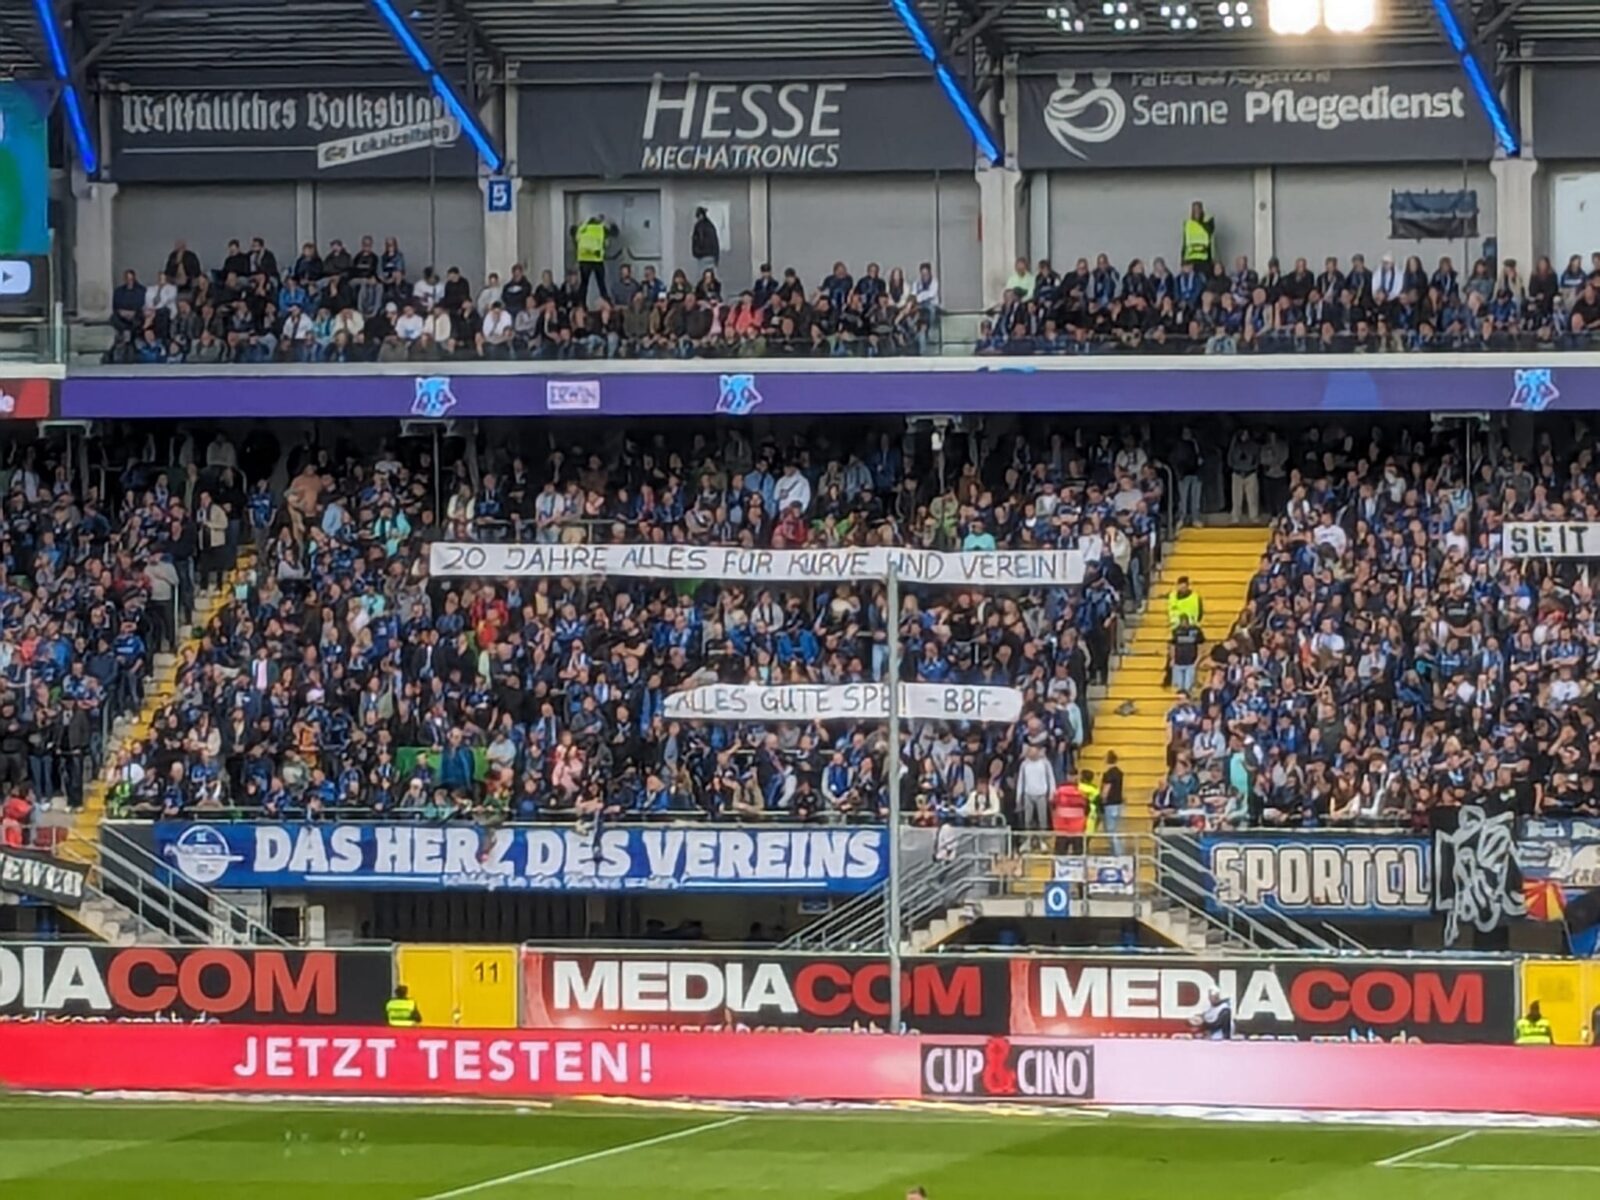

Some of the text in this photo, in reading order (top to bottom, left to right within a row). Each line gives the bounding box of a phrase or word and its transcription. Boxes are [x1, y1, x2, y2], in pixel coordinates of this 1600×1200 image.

[306, 90, 452, 131] Volksblat
[642, 72, 847, 139] HESSE
[1133, 86, 1465, 129] Senne Pflegedienst
[641, 144, 840, 171] MECHATRONICS
[492, 183, 508, 206] 5
[1511, 525, 1589, 554] SEIT
[442, 546, 487, 571] 20
[503, 547, 609, 571] JAHRE
[621, 548, 708, 572] ALLES
[787, 550, 880, 577] KURVE
[959, 553, 1068, 580] VEREIN!
[760, 687, 832, 713] GUTE
[253, 825, 882, 879] DAS HERZ DES VEREINS
[474, 960, 499, 984] 11
[553, 960, 982, 1017] MEDIACOM
[1040, 966, 1484, 1024] MEDIACOM
[233, 1036, 653, 1083] JETZT TESTEN!
